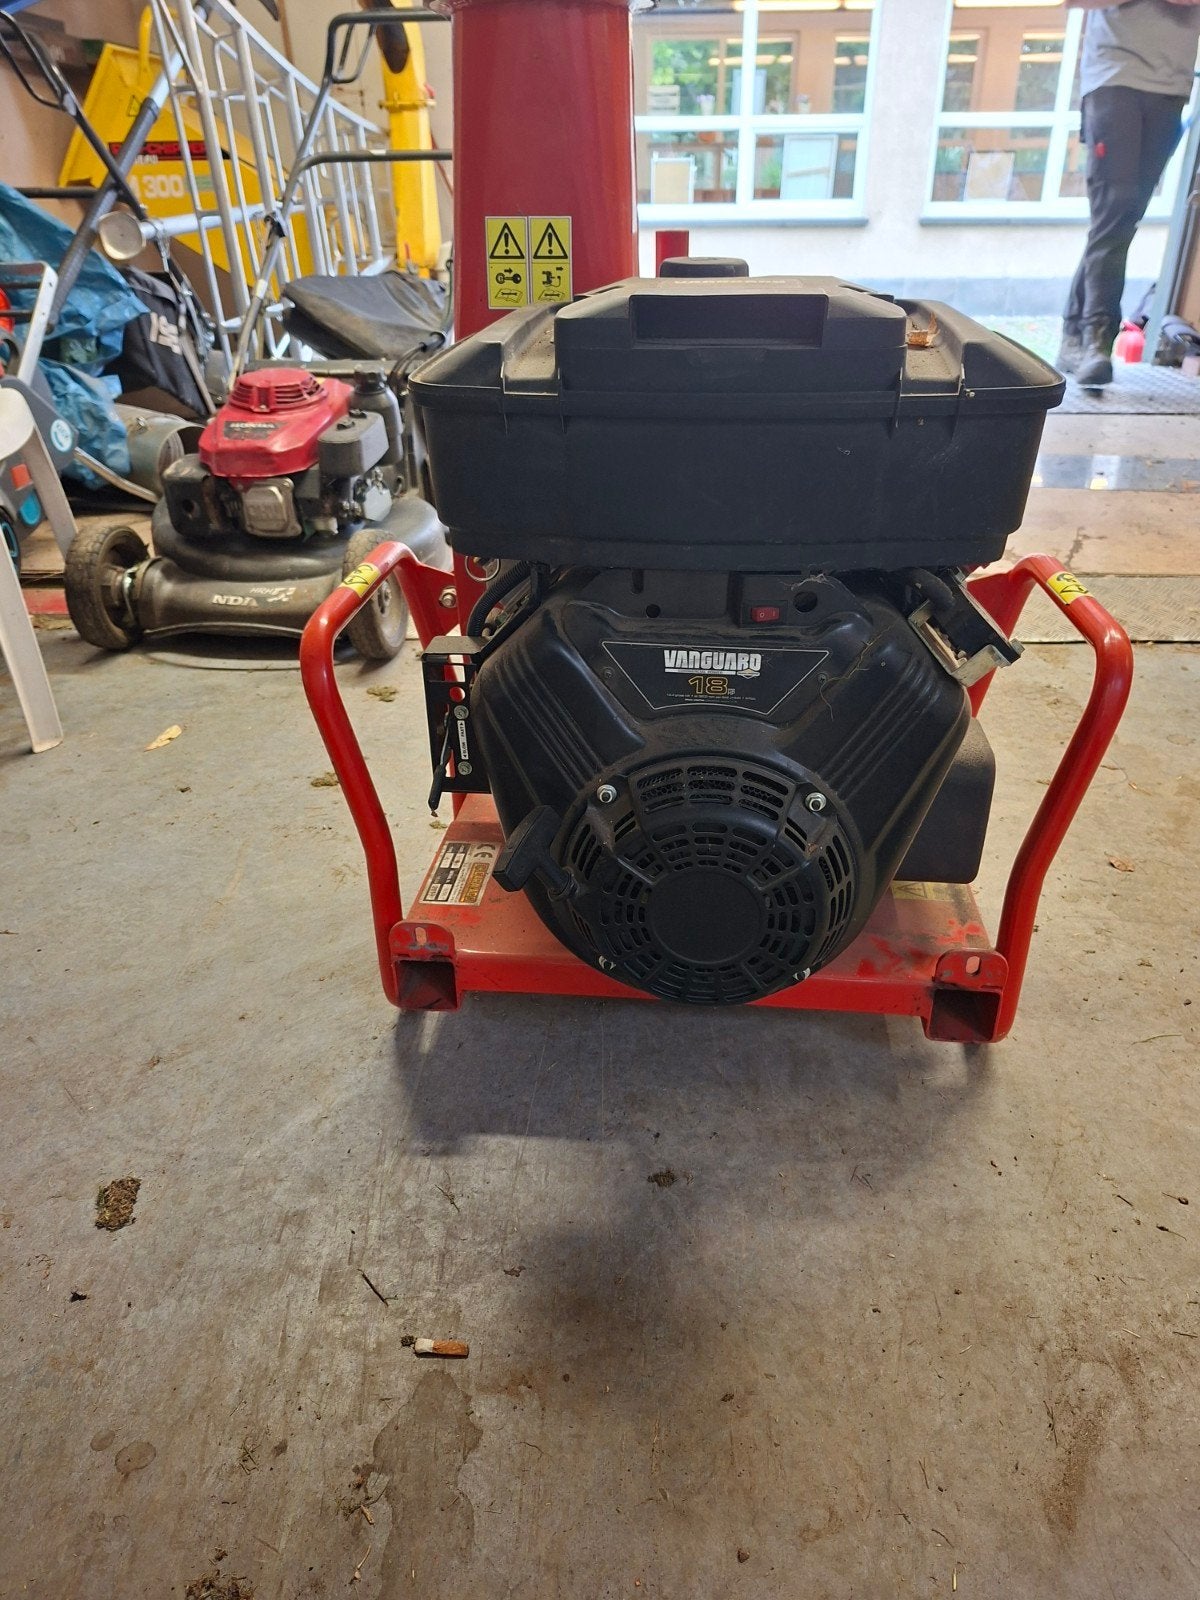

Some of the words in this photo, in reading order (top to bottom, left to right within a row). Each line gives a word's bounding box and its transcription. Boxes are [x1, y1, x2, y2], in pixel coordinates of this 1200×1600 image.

[143, 175, 184, 198] 300
[663, 649, 762, 671] VANGUARD
[687, 675, 729, 696] 18
